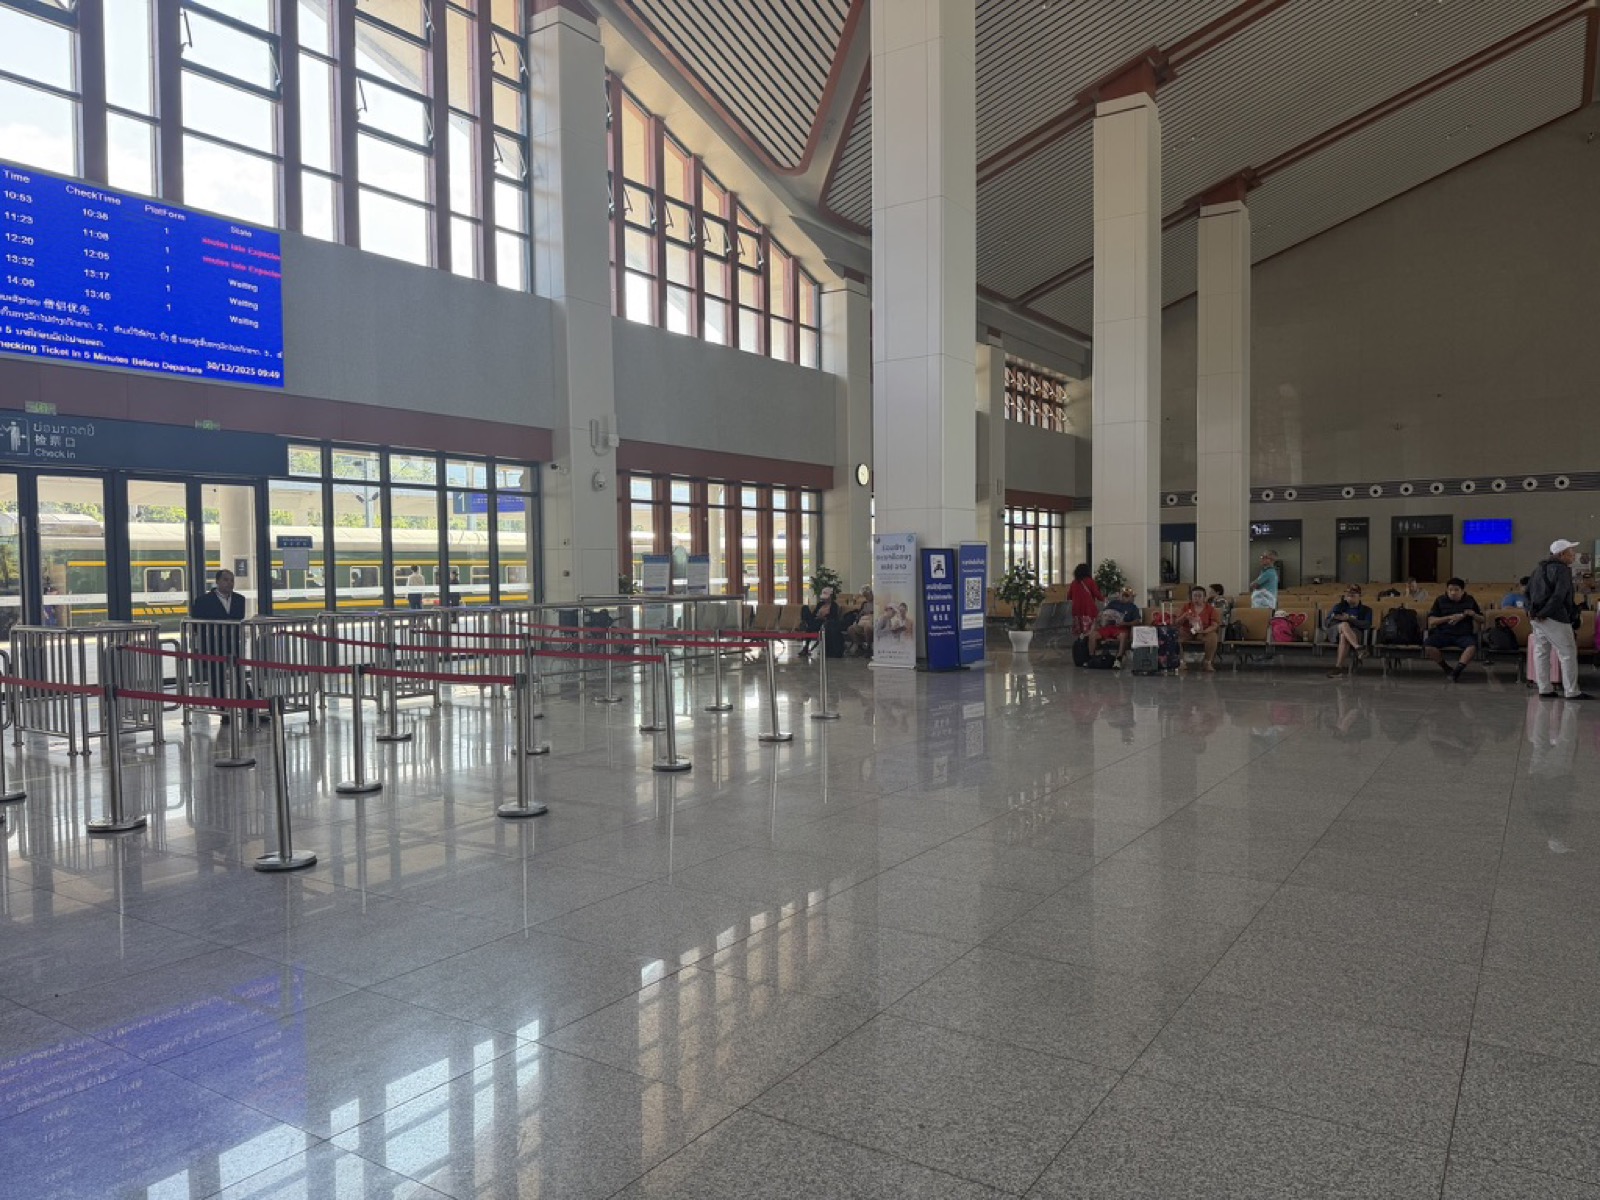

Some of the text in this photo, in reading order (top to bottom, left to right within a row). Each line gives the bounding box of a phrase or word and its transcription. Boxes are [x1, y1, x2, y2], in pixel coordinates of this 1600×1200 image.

[3, 169, 31, 183] Time
[230, 226, 252, 238] State
[4, 190, 33, 203] 10:53
[228, 279, 259, 293] Waiting
[229, 297, 259, 311] Waiting
[229, 315, 259, 329] Waiting
[40, 345, 69, 357] Ticket
[93, 352, 129, 364] Minutes
[132, 357, 160, 368] Before
[162, 362, 203, 375] Departure
[257, 368, 280, 379] 09:49
[34, 448, 66, 459] Check
